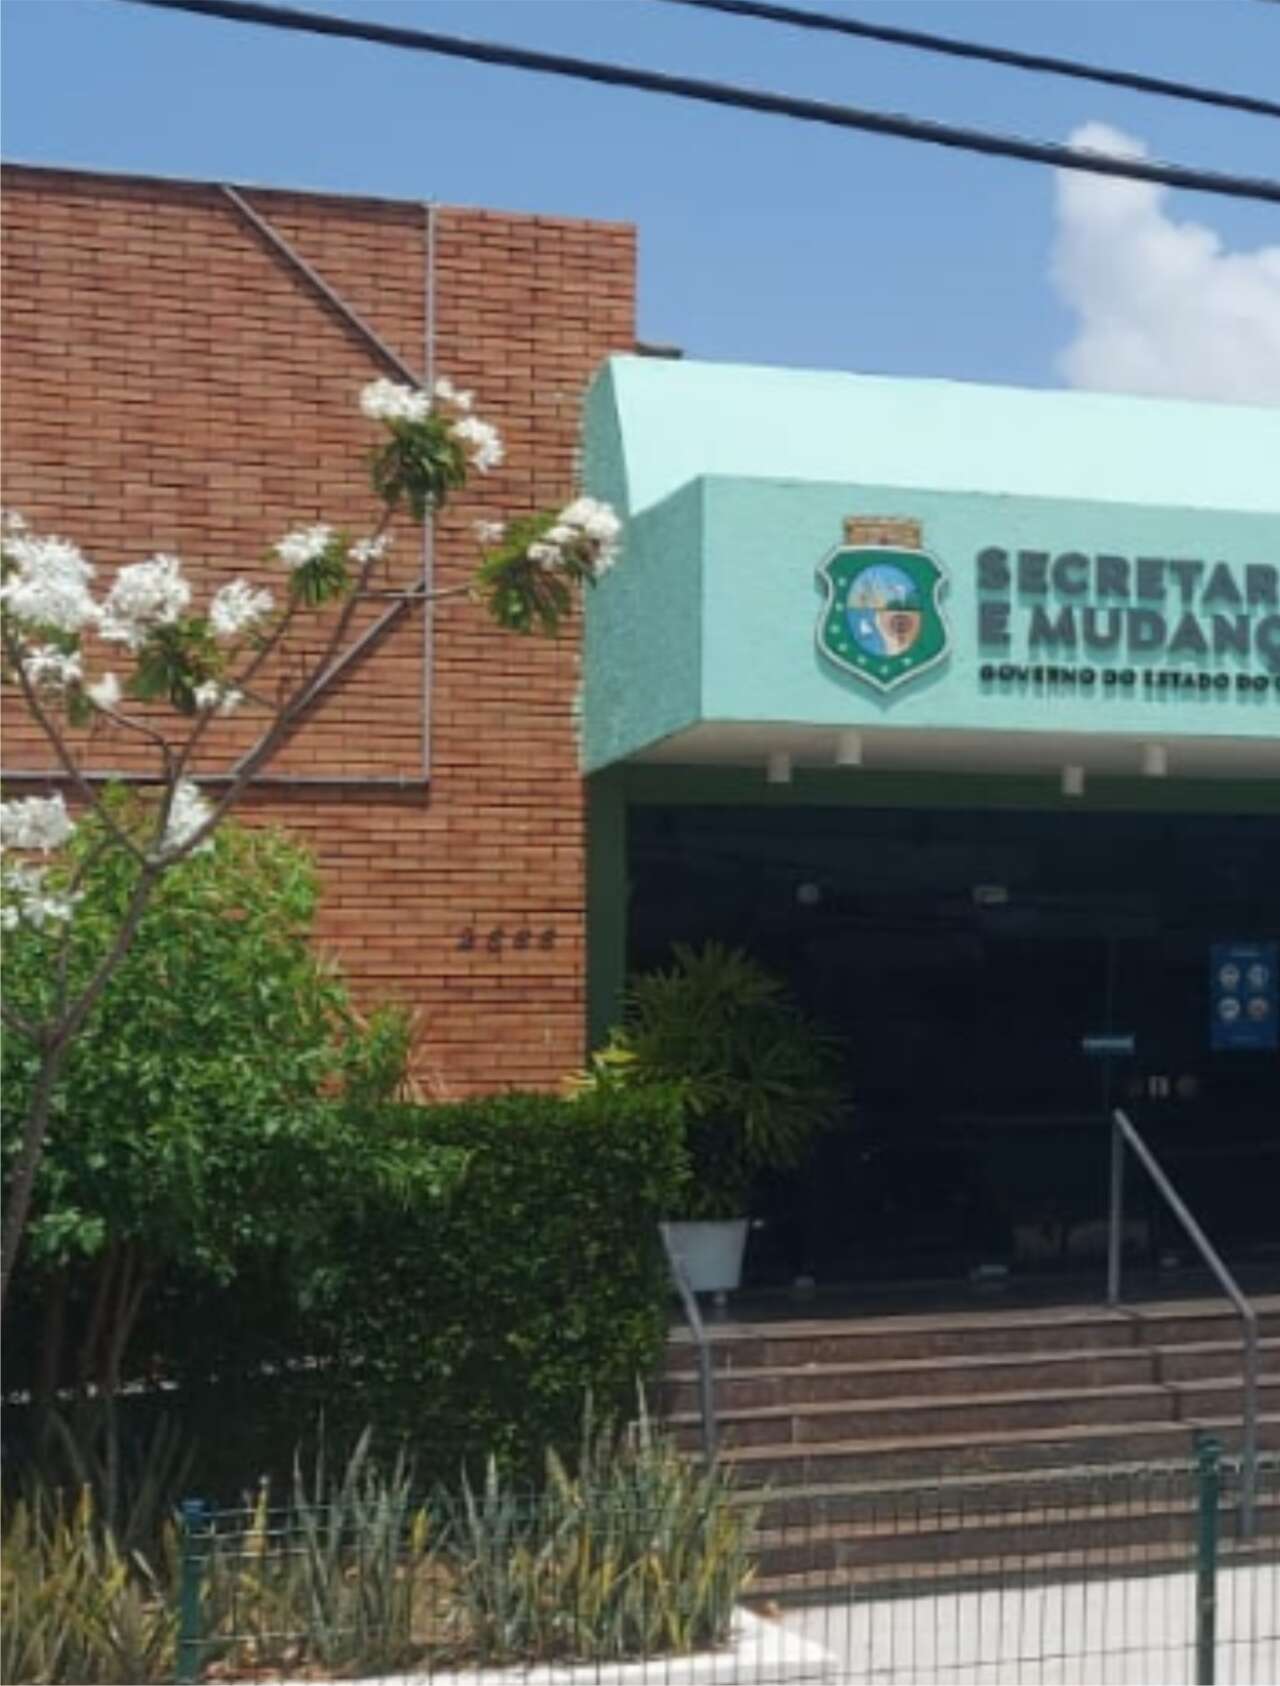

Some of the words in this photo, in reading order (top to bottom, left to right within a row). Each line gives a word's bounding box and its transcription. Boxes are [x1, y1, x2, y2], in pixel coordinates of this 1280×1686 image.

[978, 602, 1011, 646] E
[979, 664, 1095, 684] GOVERNO
[1104, 669, 1137, 687] DO
[1144, 671, 1230, 690] ESTADO
[1236, 674, 1268, 690] DO
